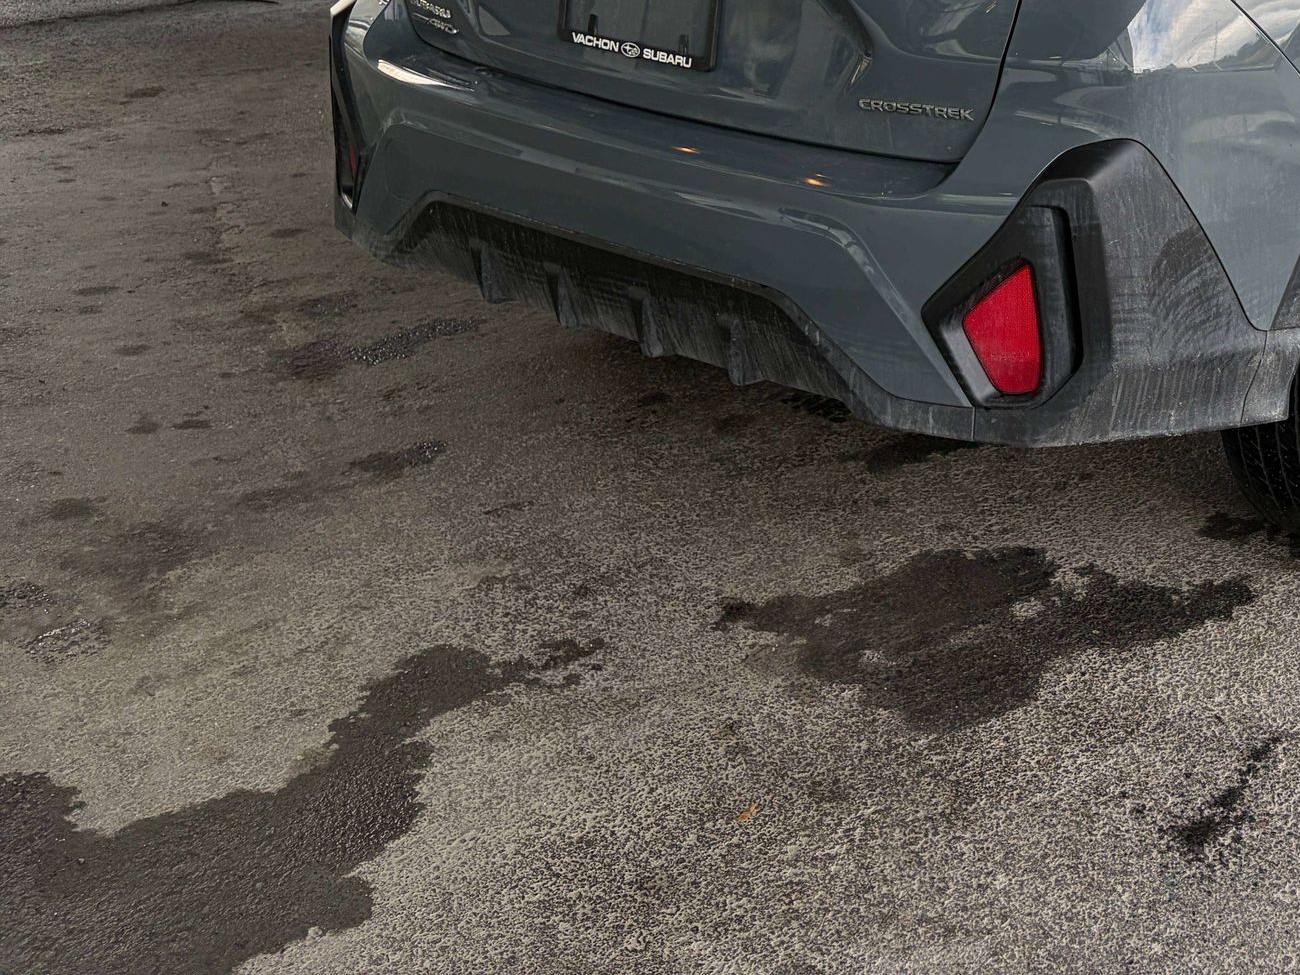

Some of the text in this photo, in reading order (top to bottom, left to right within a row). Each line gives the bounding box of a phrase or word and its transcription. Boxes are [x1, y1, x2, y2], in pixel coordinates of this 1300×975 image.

[572, 31, 692, 68] VACHON SUBARU
[858, 98, 975, 122] CROSSTREK
